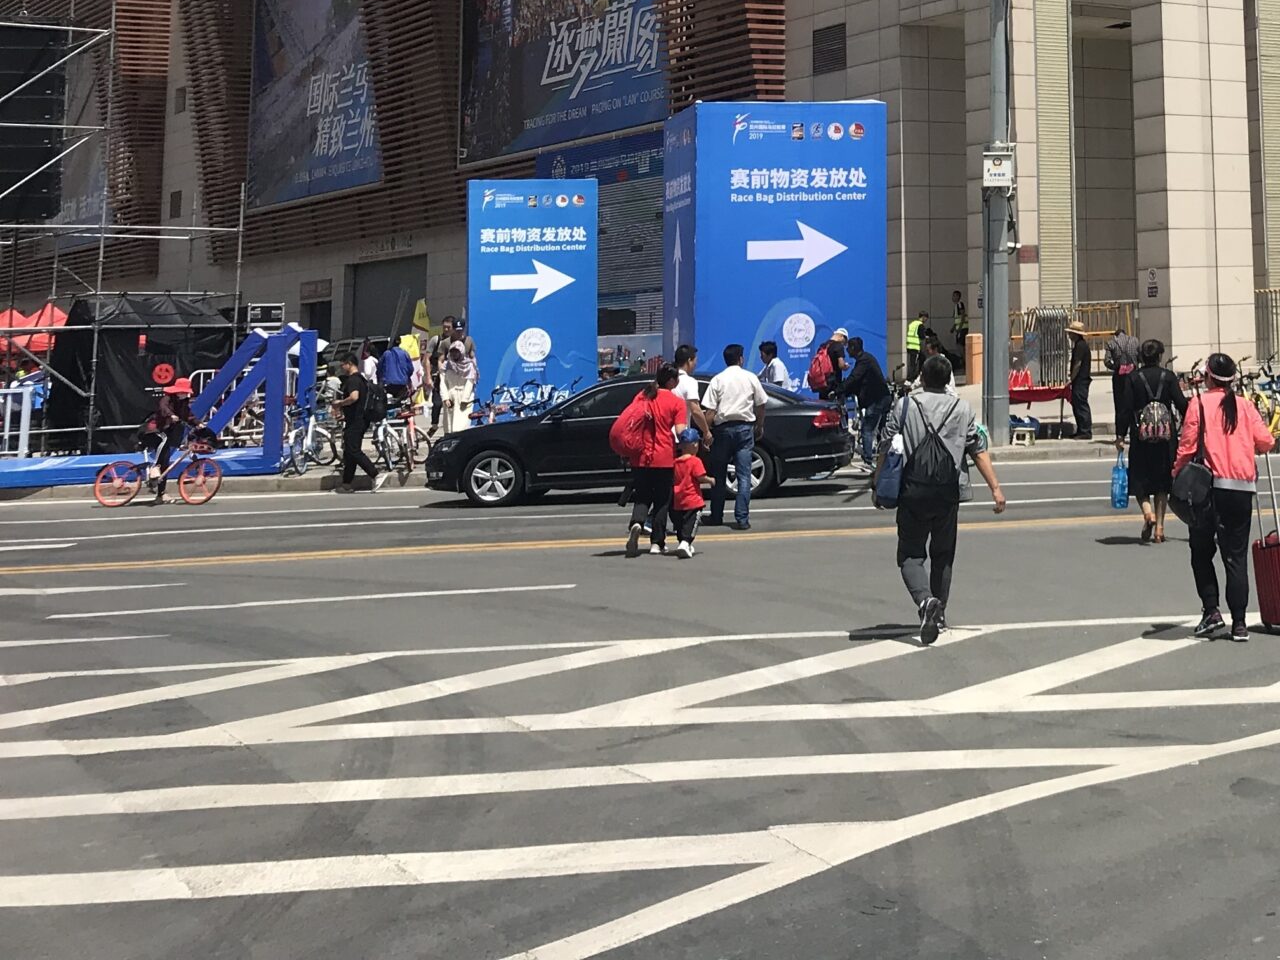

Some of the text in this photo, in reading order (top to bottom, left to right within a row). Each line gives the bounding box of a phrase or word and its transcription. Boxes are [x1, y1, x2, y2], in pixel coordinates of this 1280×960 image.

[640, 87, 665, 102] COURSE
[557, 110, 568, 122] THE
[567, 106, 588, 121] DREAM
[730, 168, 868, 190] 赛前物资发放处
[730, 191, 867, 204] Race Bag Distribution Center
[480, 226, 587, 243] 赛前物资发放处
[480, 243, 587, 254] Race Bag Distribution Center
